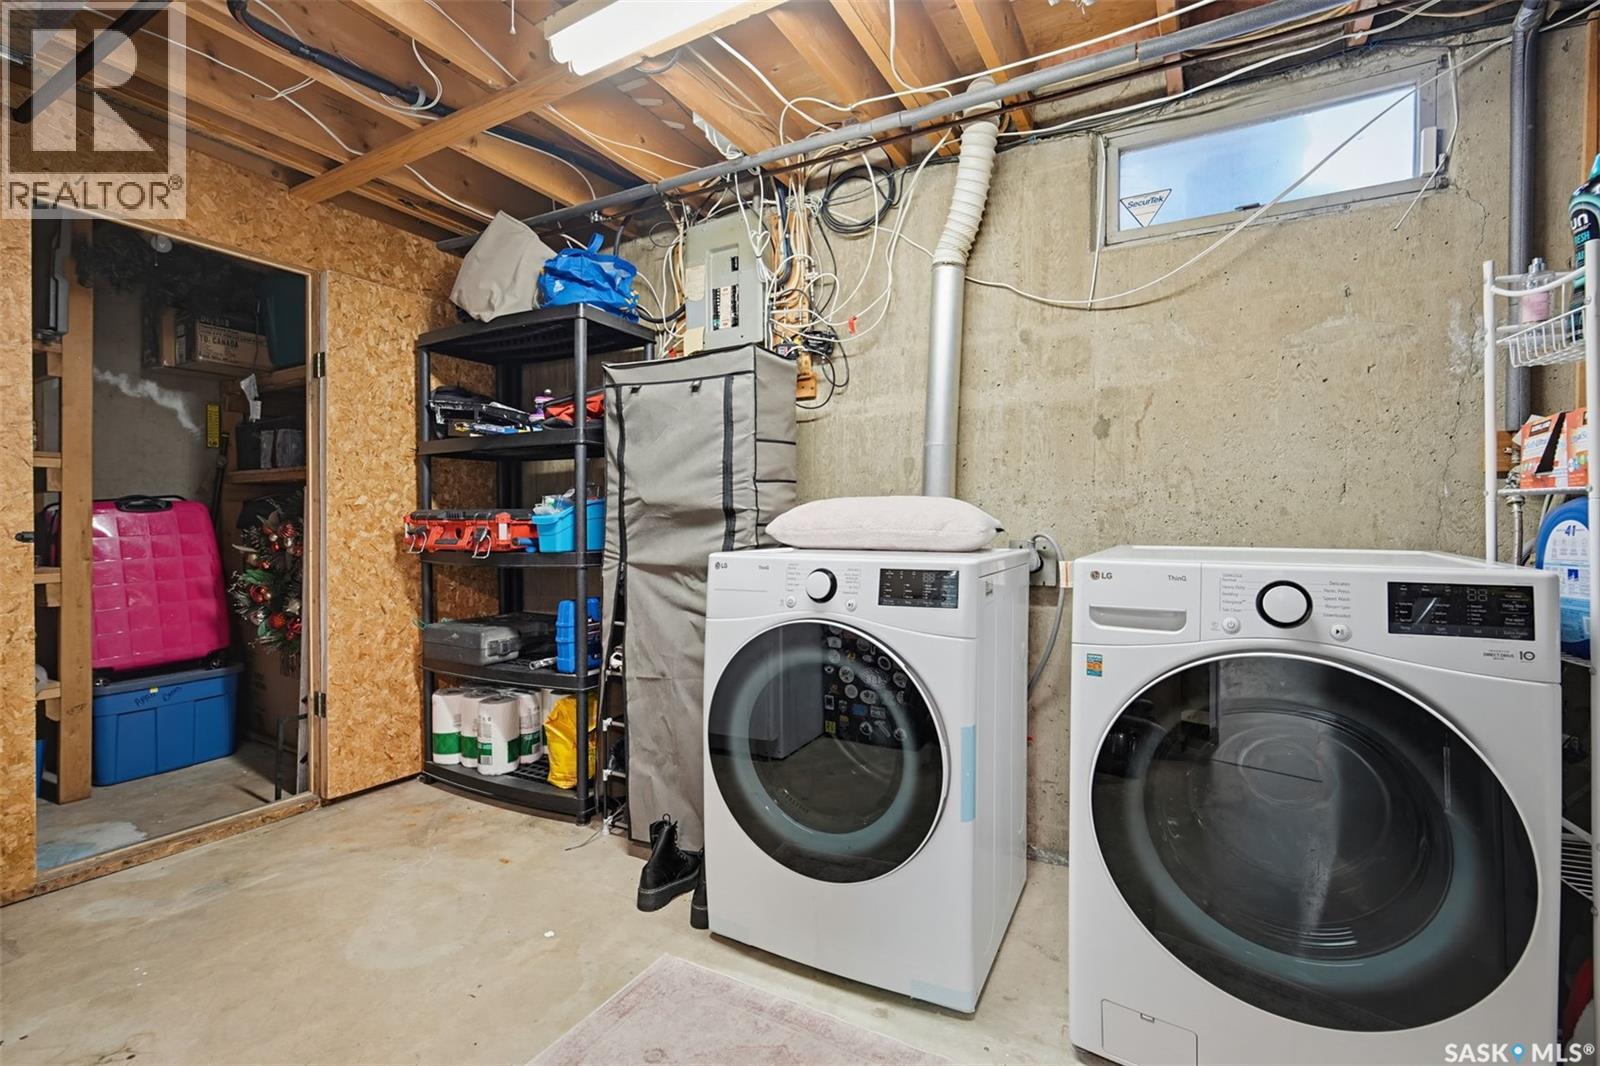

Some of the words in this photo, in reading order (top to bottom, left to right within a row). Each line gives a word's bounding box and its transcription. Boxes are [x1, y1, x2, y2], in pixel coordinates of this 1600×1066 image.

[1127, 195, 1164, 209] SecurTek
[212, 336, 240, 348] CANADA
[1167, 574, 1187, 582] ThinQ
